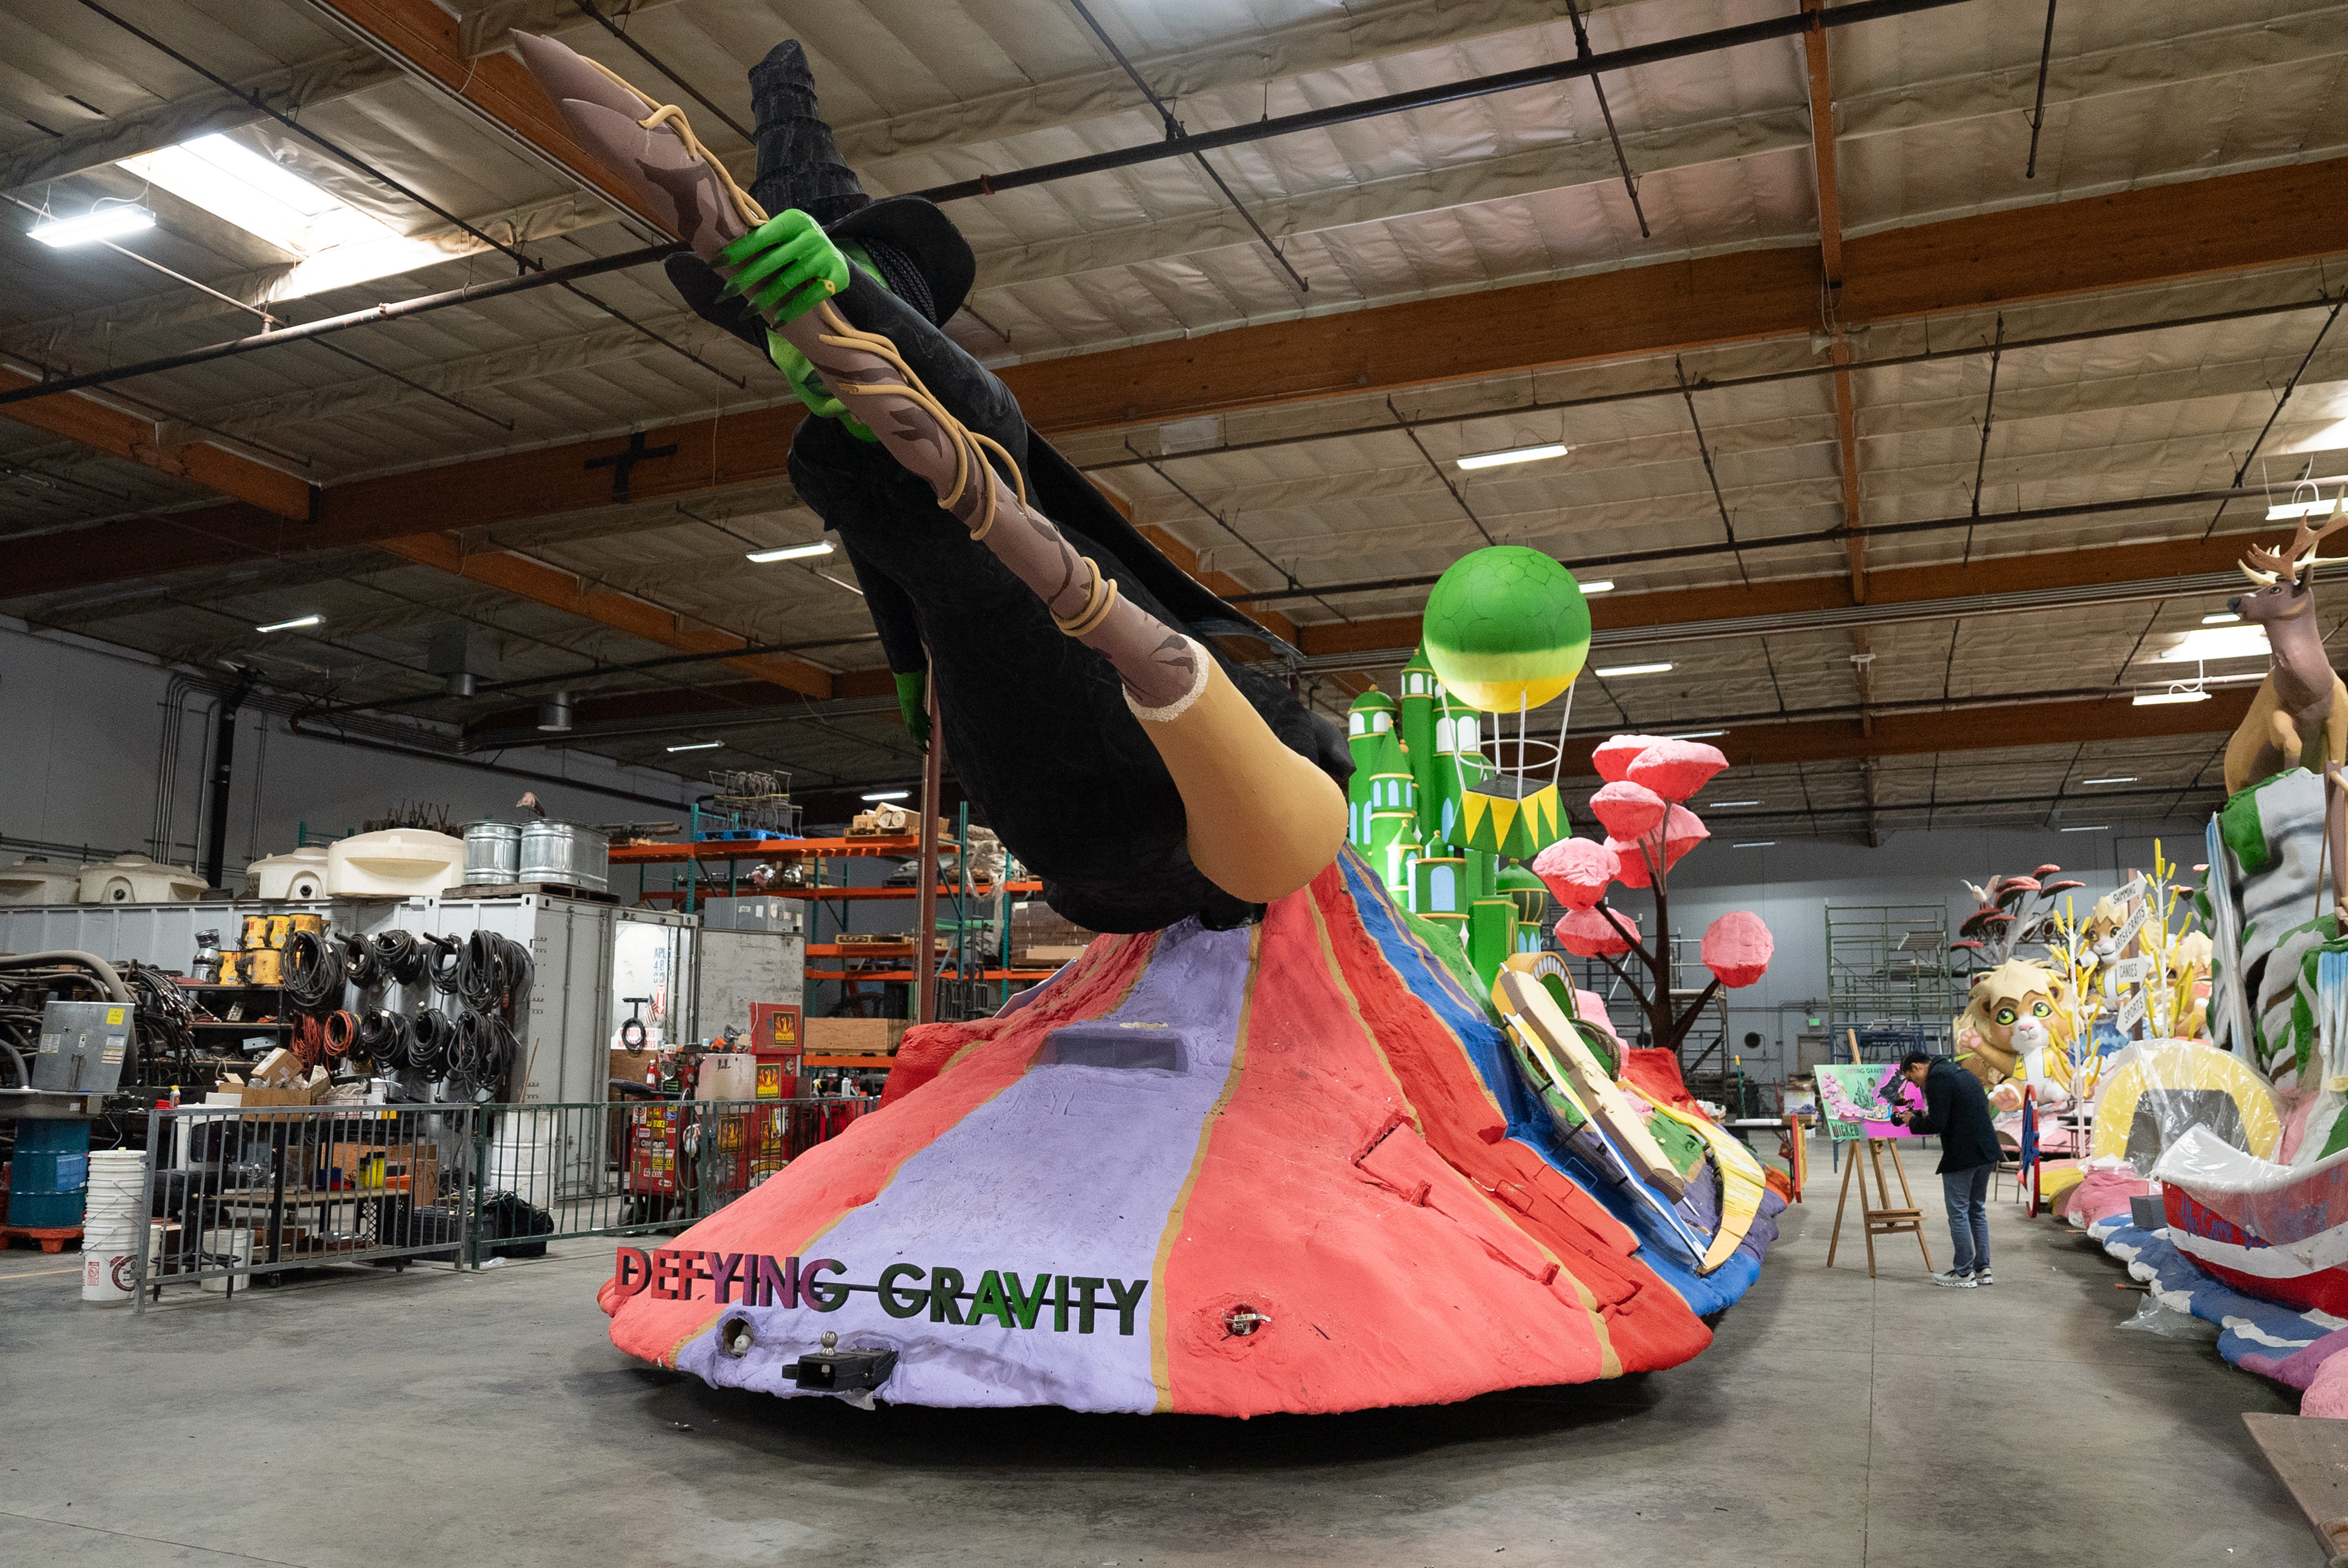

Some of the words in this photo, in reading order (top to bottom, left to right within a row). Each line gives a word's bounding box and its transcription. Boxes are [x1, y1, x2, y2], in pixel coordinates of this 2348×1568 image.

[2113, 883, 2136, 904] SWIMMING
[654, 947, 666, 958] APL
[2119, 963, 2137, 978] CANOES
[2125, 997, 2143, 1024] SPORTS
[1831, 1122, 1860, 1138] WICKED
[615, 1246, 849, 1313] DEFYING
[878, 1262, 1149, 1336] GRAVITY
